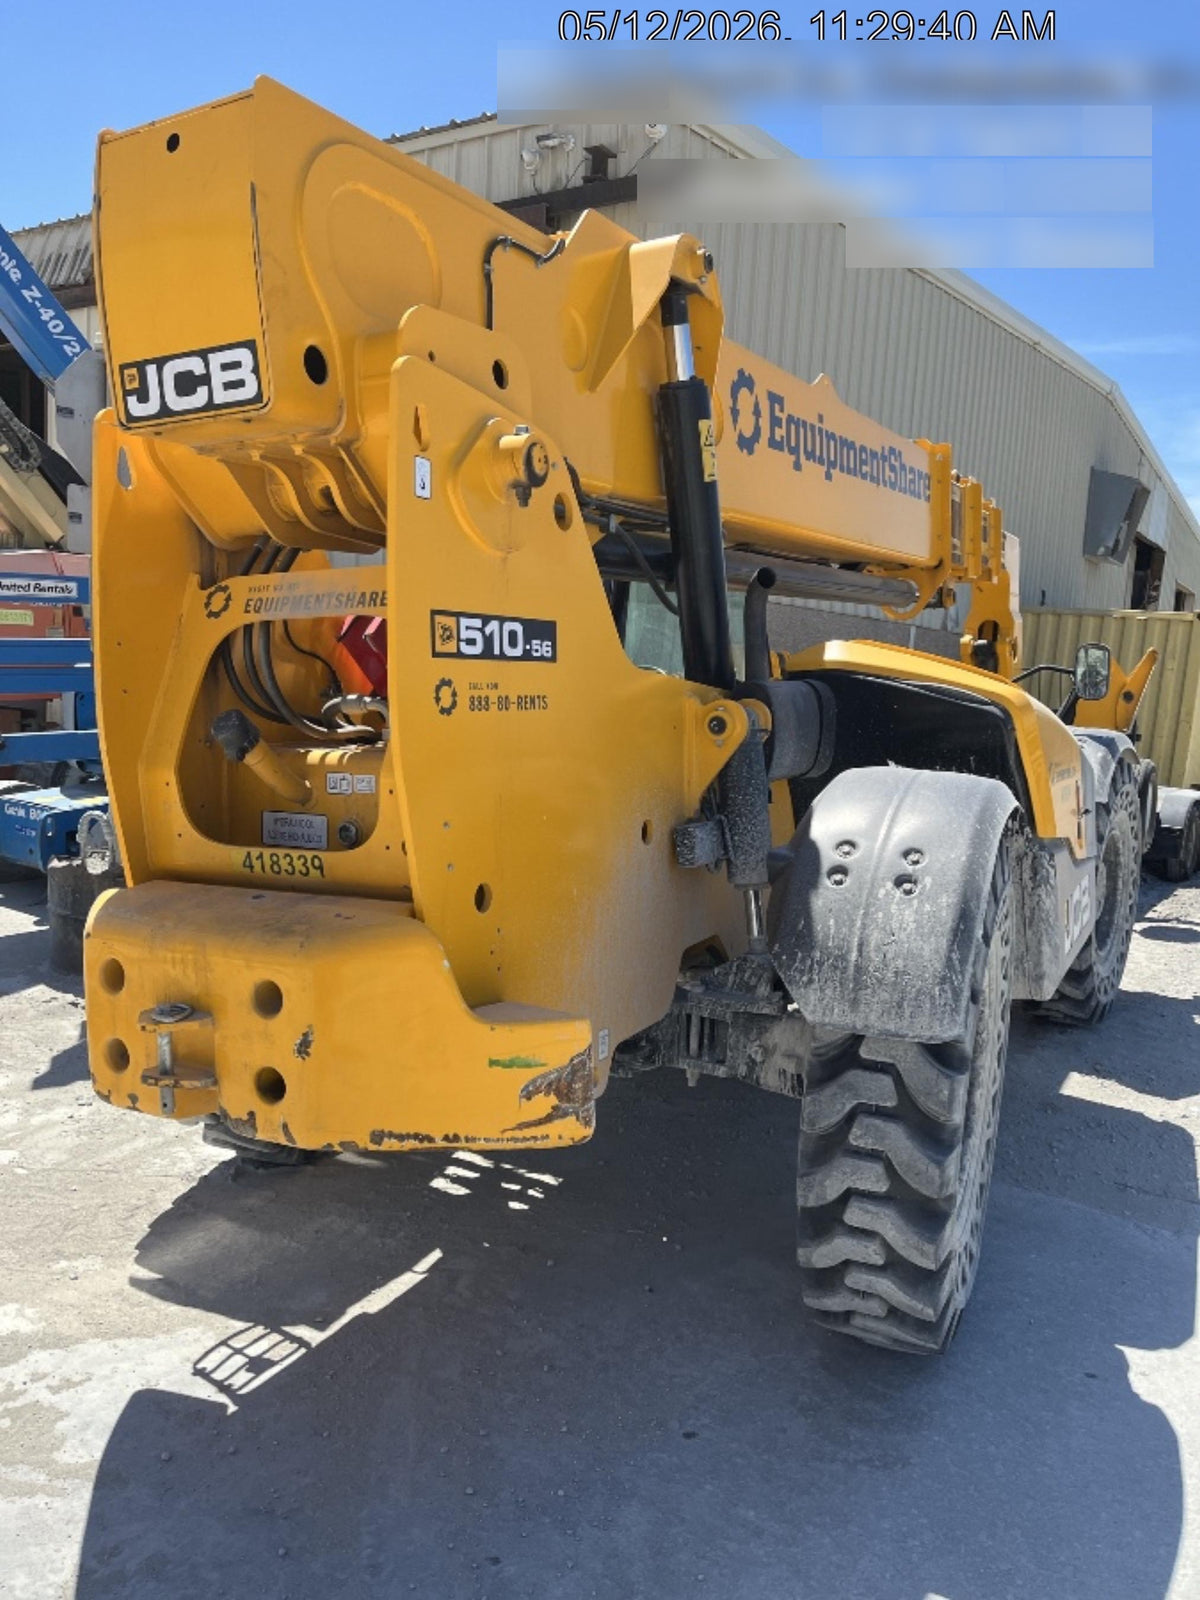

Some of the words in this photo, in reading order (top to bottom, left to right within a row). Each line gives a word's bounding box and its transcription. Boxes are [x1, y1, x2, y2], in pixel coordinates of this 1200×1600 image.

[21, 285, 81, 361] Z-40/2
[126, 348, 258, 417] JCB
[766, 389, 931, 503] EquipmentShare
[33, 582, 73, 594] Rentals
[244, 591, 387, 613] EQUIPMENTSHARE
[243, 851, 325, 877] 418339
